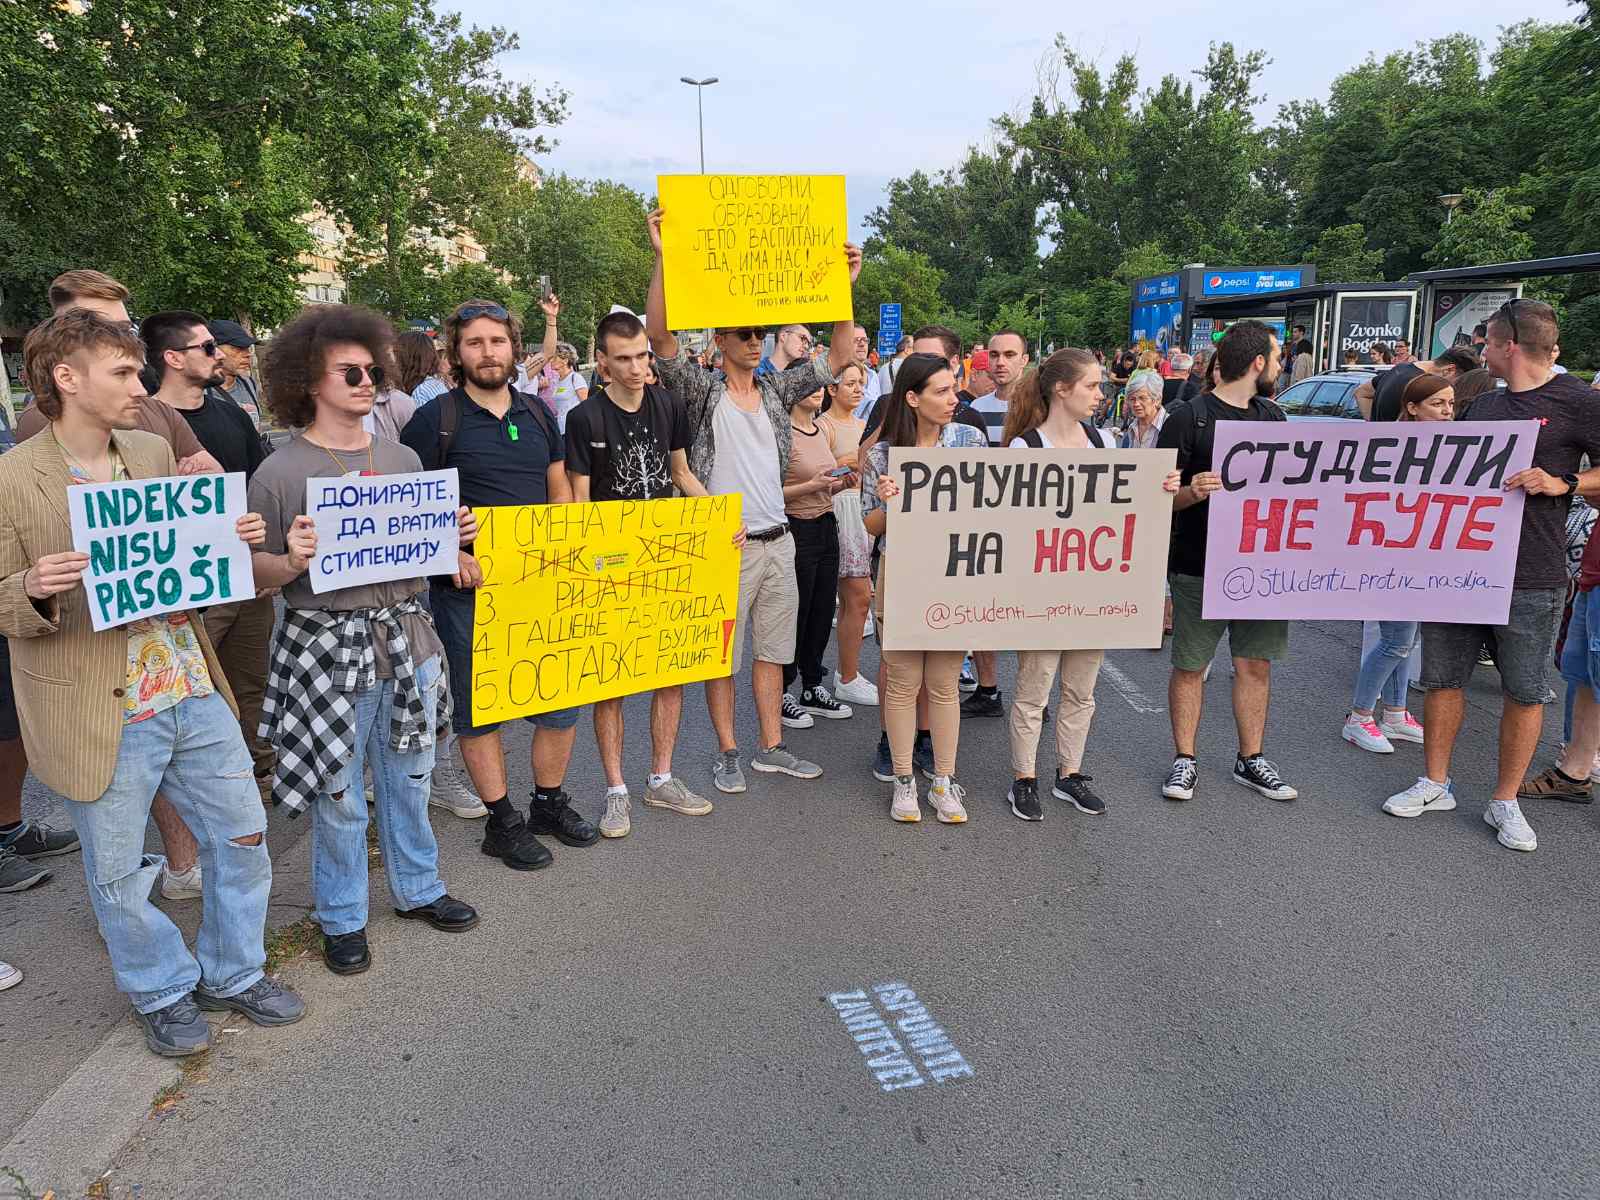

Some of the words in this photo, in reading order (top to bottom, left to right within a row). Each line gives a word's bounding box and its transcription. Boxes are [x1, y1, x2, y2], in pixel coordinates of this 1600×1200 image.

[693, 228, 736, 251] ЛЕПО
[749, 226, 836, 248] ВАСПИТАНИ
[713, 203, 809, 226] ОБРАЗОВАНИ
[704, 253, 733, 273] ДА,
[739, 250, 769, 272] ИМА
[775, 249, 810, 270] НАС!
[728, 270, 804, 296] СТУДЕНТИ
[1224, 277, 1250, 288] pepsi
[1350, 323, 1402, 337] Zvonko
[1221, 433, 1519, 491] СТУДЕНТИ
[84, 476, 225, 529] INDEKSI
[337, 517, 376, 541] ДА
[388, 510, 456, 536] ВРАТИМ
[514, 503, 605, 546] СМЕНА
[620, 499, 668, 533] РТС
[1238, 499, 1318, 553] НЕ
[1344, 492, 1503, 551] ЋУТЕ
[90, 528, 176, 577] NISU
[945, 532, 1003, 577] НА
[1034, 514, 1136, 573] НАС!
[95, 544, 231, 623] PASOŠI
[508, 611, 608, 656] ГАШЕЊЕ
[614, 594, 725, 632] ТАБЛОИДА
[509, 636, 652, 705] ОСТАВКЕ
[659, 621, 719, 652] ВУЛИН
